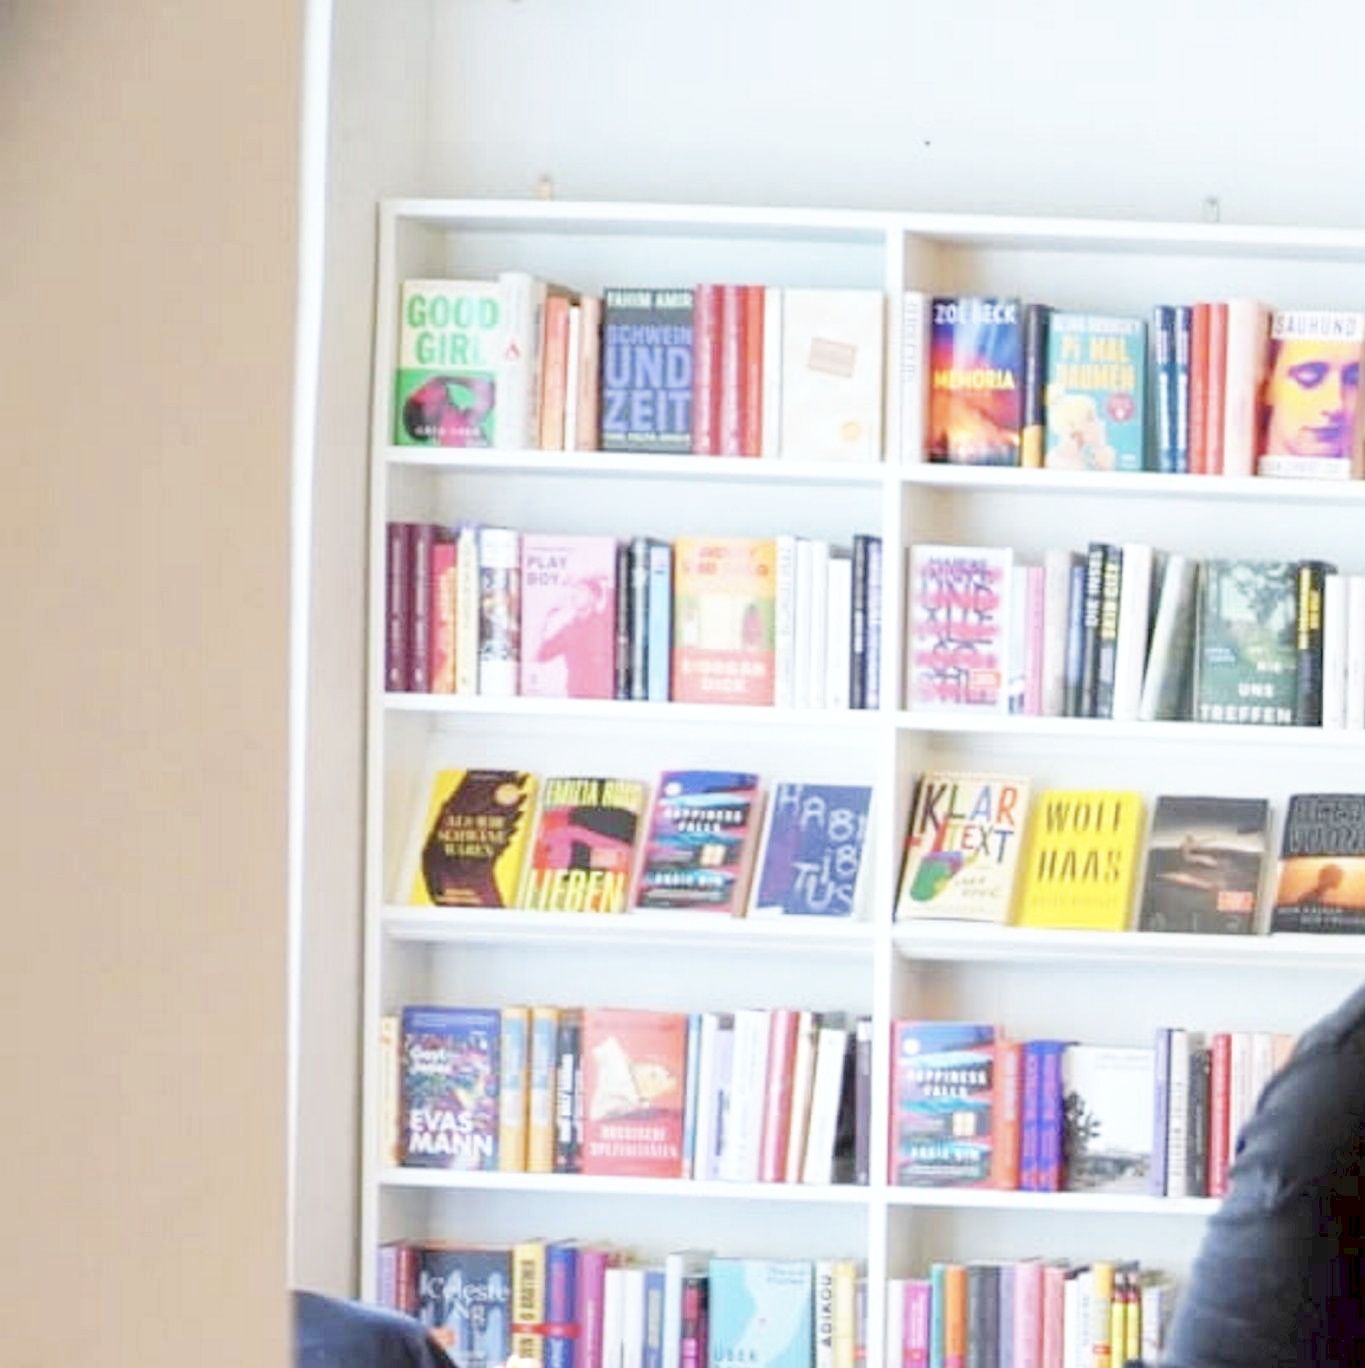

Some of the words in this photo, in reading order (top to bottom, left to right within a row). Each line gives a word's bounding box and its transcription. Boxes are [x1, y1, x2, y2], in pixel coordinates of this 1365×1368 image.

[407, 295, 499, 329] GOOD
[415, 331, 483, 366] GIRL
[606, 348, 693, 390] UND
[604, 391, 693, 433] ZEIT
[526, 556, 568, 570] PLAY
[918, 782, 1018, 833] KLAR
[945, 822, 1015, 864] TEXT
[1038, 848, 1123, 882] HAAS
[528, 870, 626, 913] LIEBEN
[409, 1110, 473, 1132] EVAS
[409, 1132, 493, 1157] MANN
[820, 1273, 834, 1349] ADIKOU
